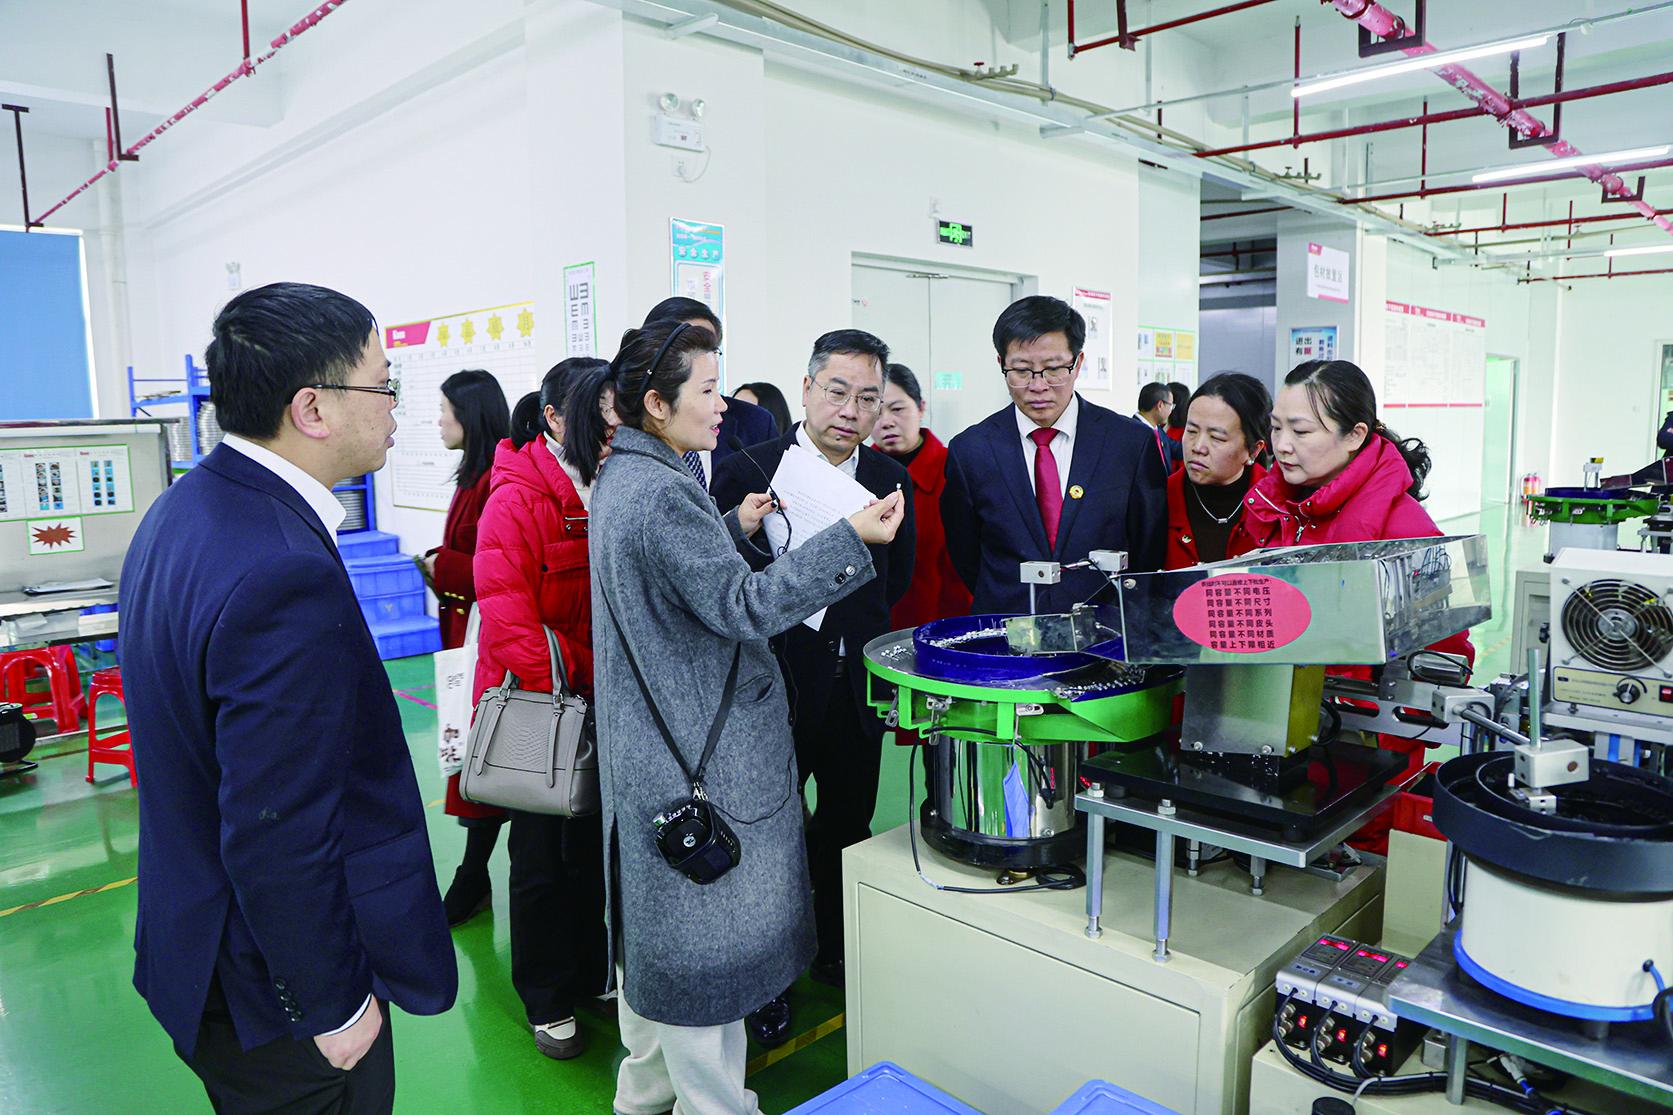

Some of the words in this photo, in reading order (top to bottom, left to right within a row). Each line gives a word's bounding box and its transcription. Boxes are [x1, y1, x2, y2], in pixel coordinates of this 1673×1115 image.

[1206, 587, 1270, 597] 同容量不同电压
[1207, 598, 1271, 607] 同容量不同尺寸
